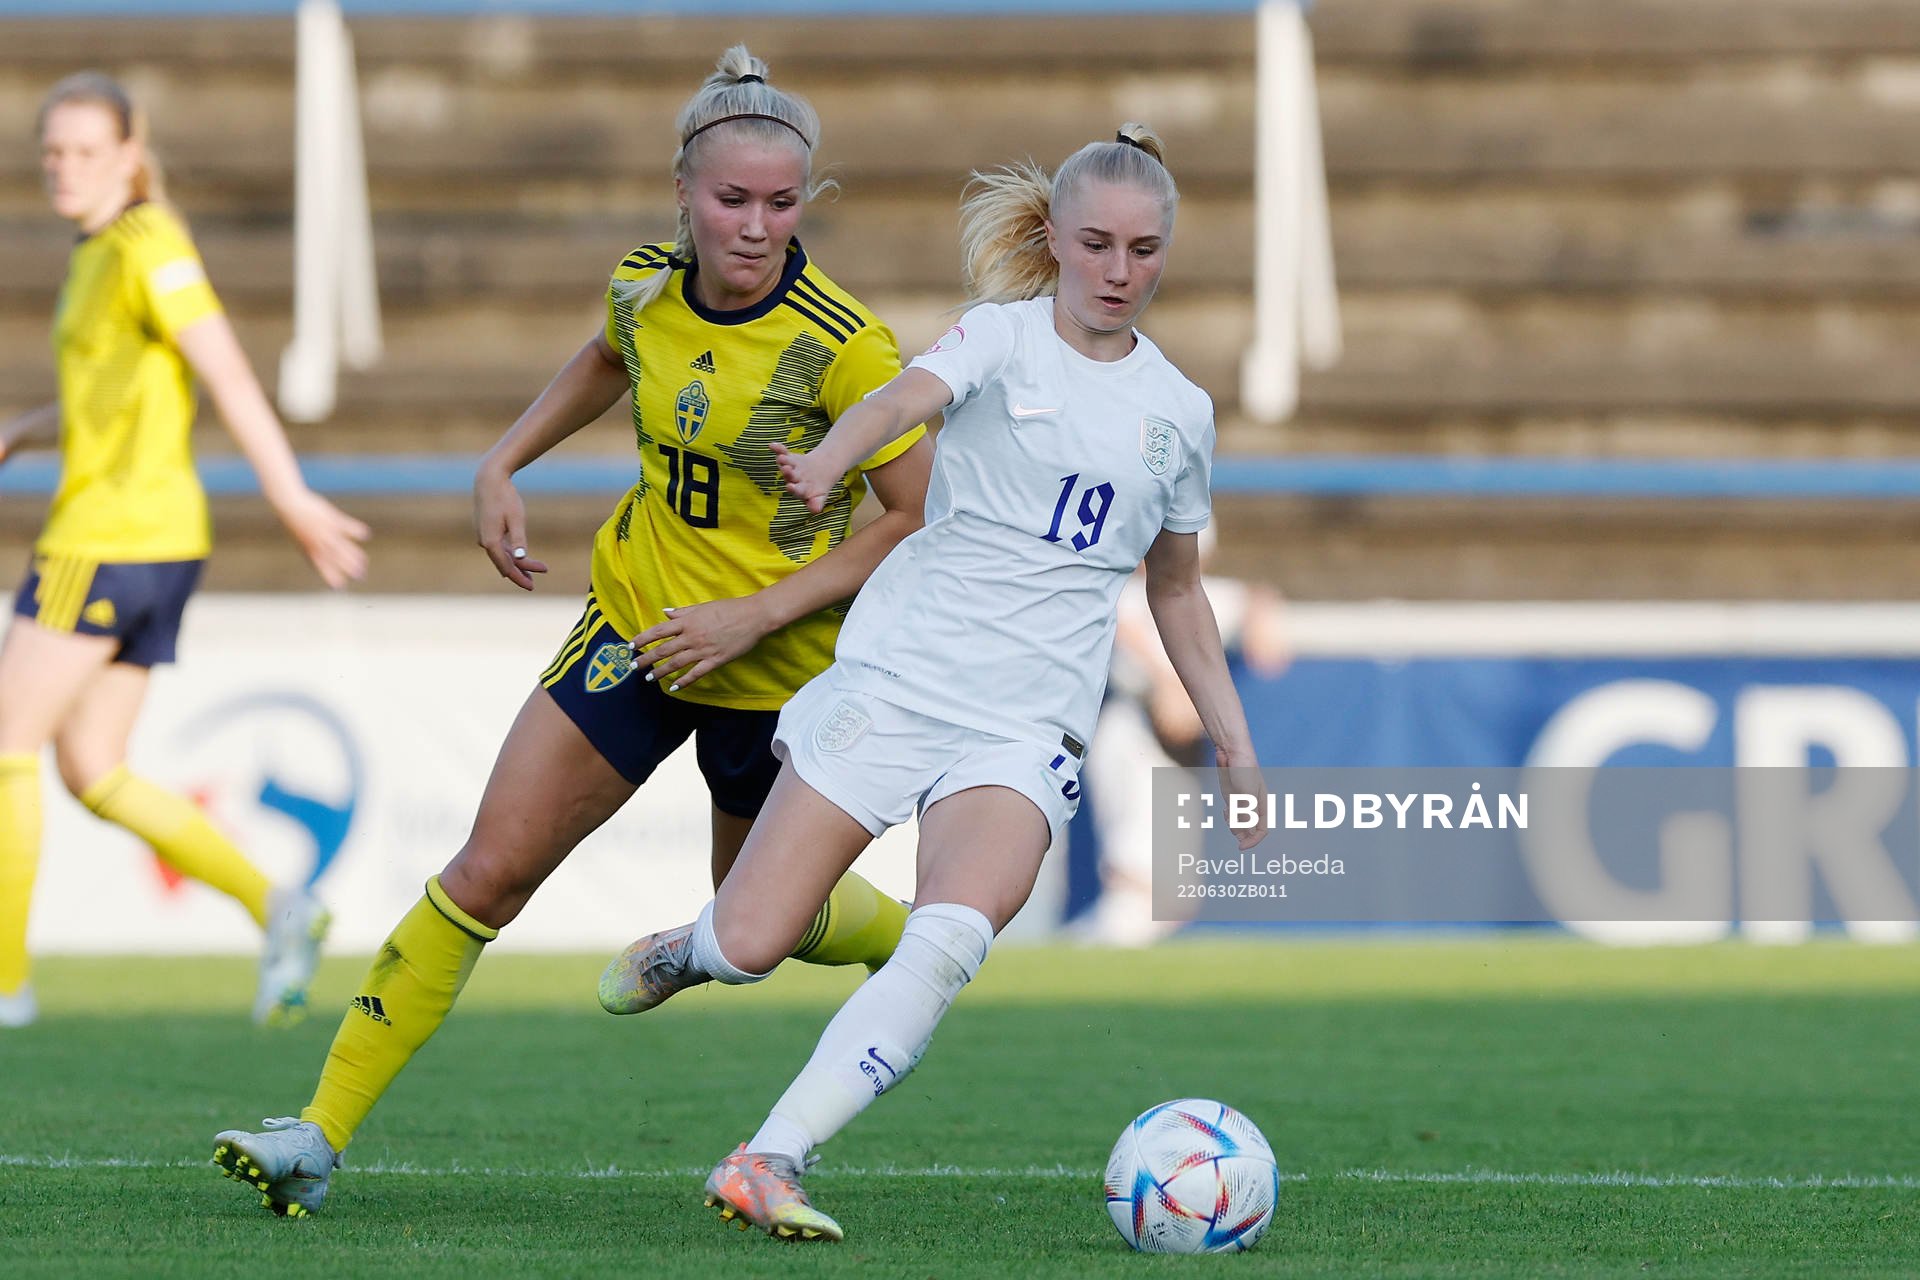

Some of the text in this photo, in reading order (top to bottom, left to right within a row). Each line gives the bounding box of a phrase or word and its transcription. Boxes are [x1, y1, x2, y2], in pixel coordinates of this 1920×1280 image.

[658, 443, 720, 529] 18
[1039, 472, 1116, 553] 19
[1518, 677, 1920, 947] GR
